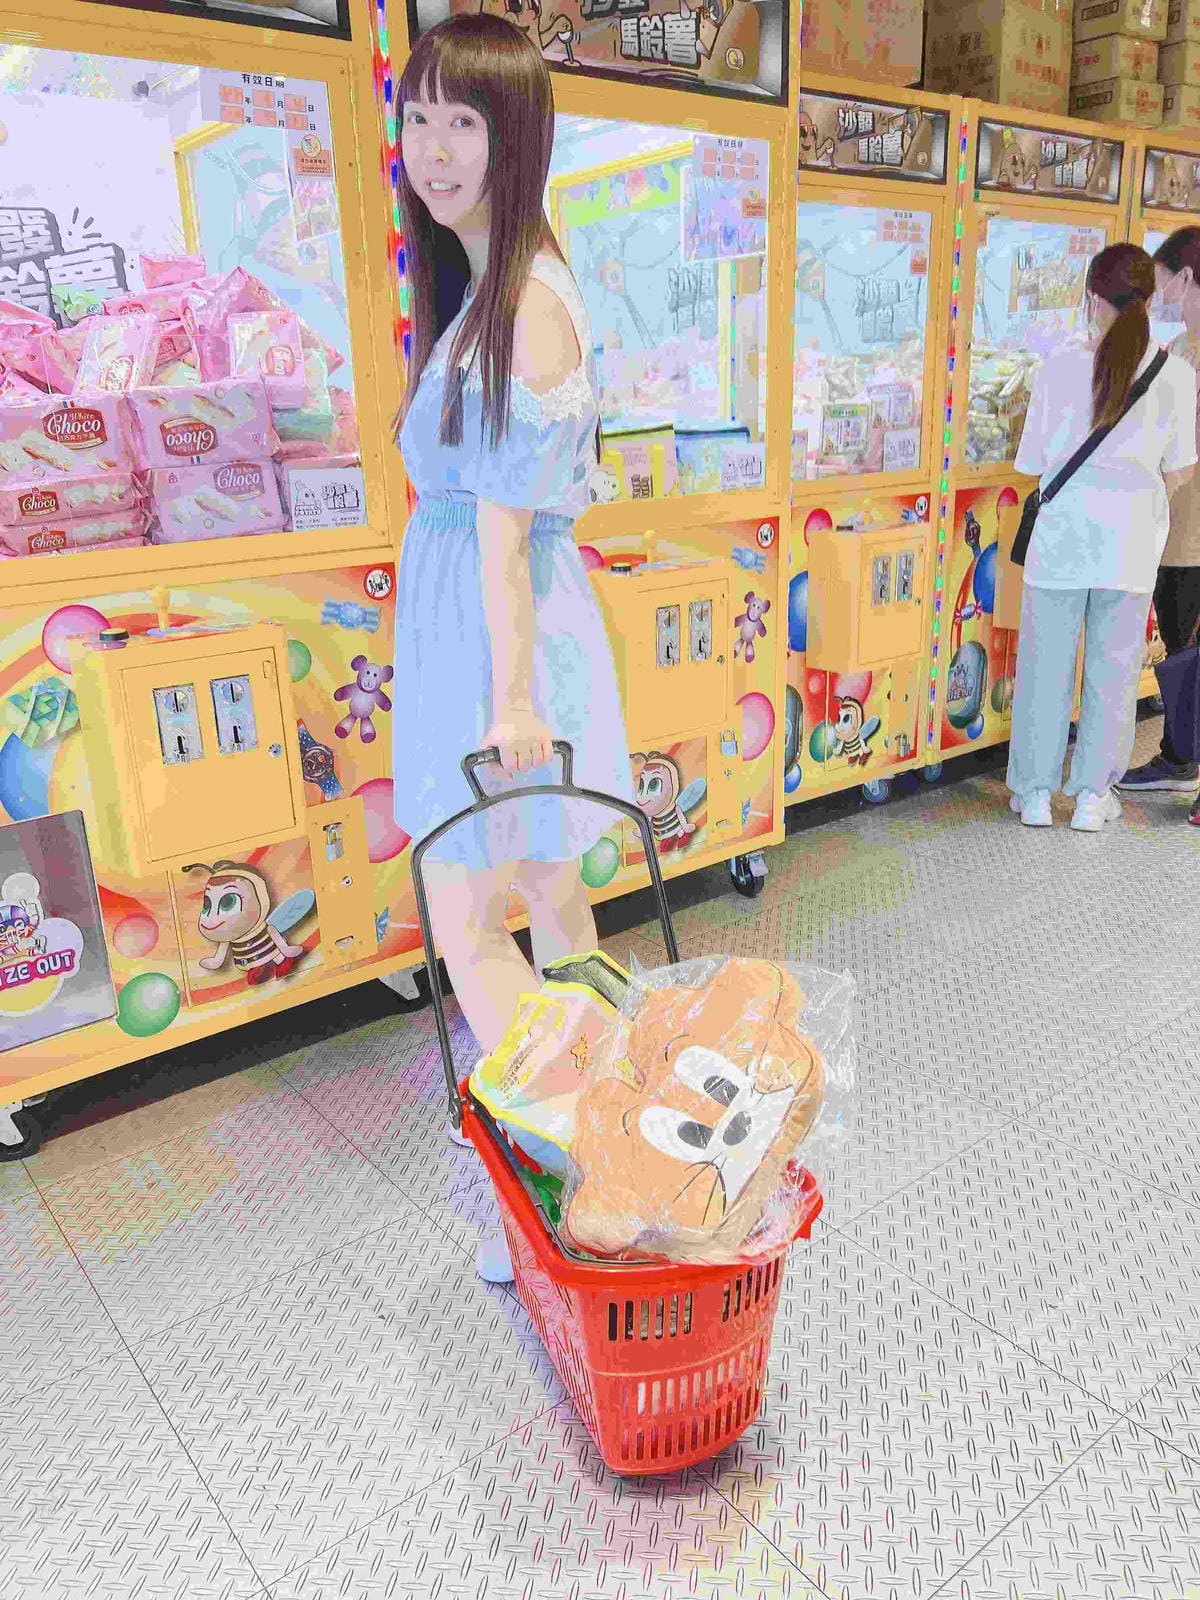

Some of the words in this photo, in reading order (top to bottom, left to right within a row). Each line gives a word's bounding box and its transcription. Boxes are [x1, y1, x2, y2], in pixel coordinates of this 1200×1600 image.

[47, 413, 101, 435] Choco
[166, 429, 214, 451] Choco
[217, 467, 260, 489] Choco
[22, 495, 56, 511] Choco
[32, 533, 64, 549] Choco
[36, 952, 72, 975] OUT
